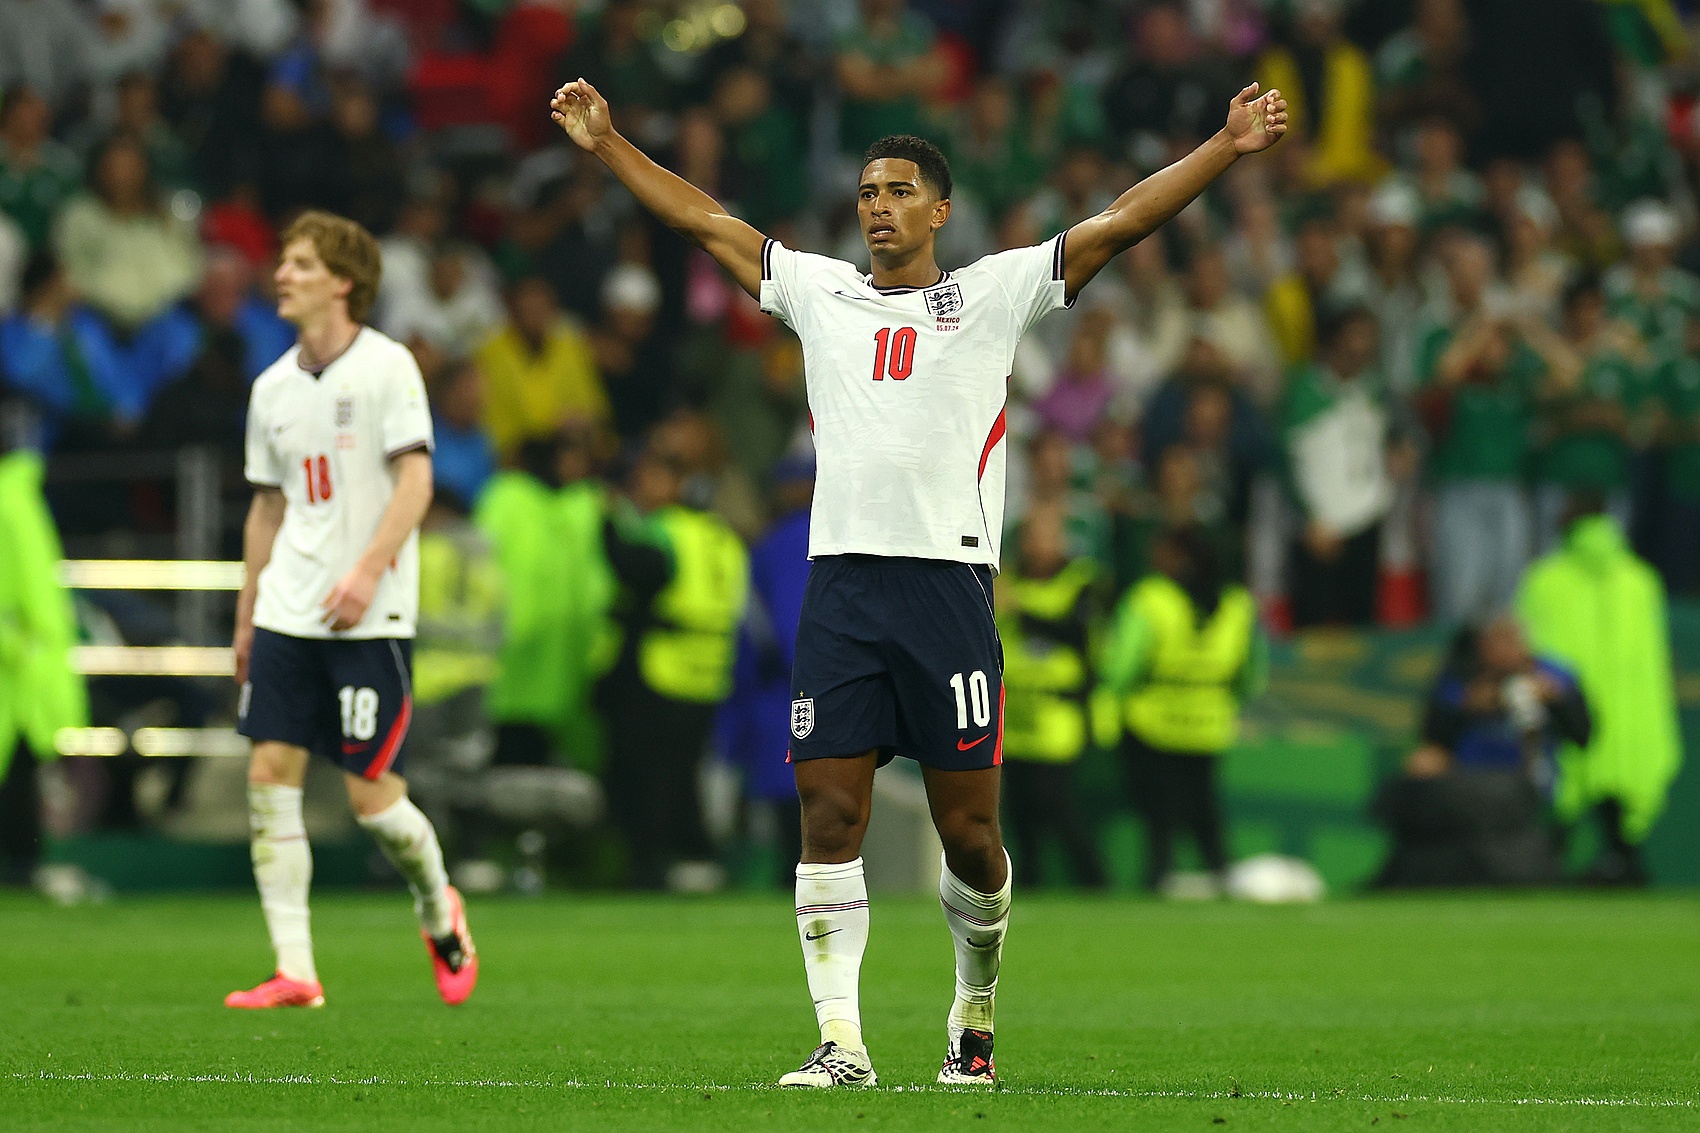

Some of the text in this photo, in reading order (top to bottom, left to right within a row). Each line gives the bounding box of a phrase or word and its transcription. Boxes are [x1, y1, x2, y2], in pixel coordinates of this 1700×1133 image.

[872, 326, 917, 381] 10
[304, 455, 331, 504] 18
[338, 685, 379, 740] 18
[949, 670, 991, 729] 10
